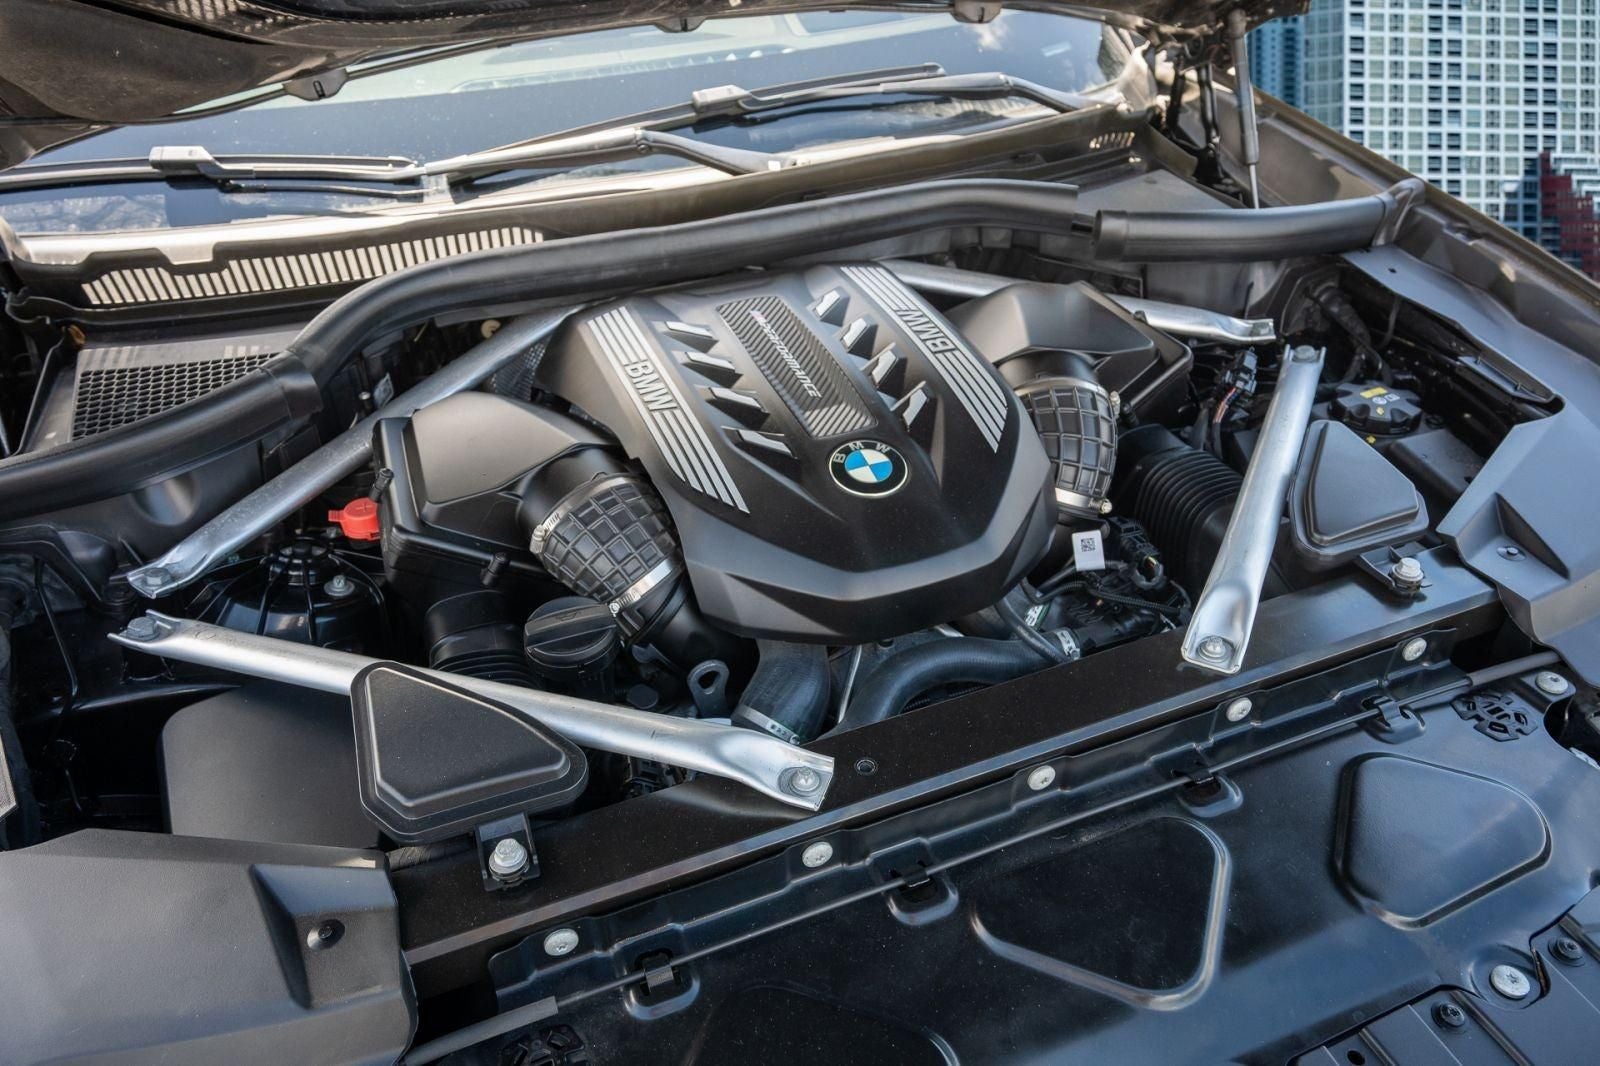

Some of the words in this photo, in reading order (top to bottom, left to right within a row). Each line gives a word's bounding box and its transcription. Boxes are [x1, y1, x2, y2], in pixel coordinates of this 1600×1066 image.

[896, 309, 956, 352] BMW
[624, 360, 678, 411] BMW
[833, 441, 891, 463] BMW
